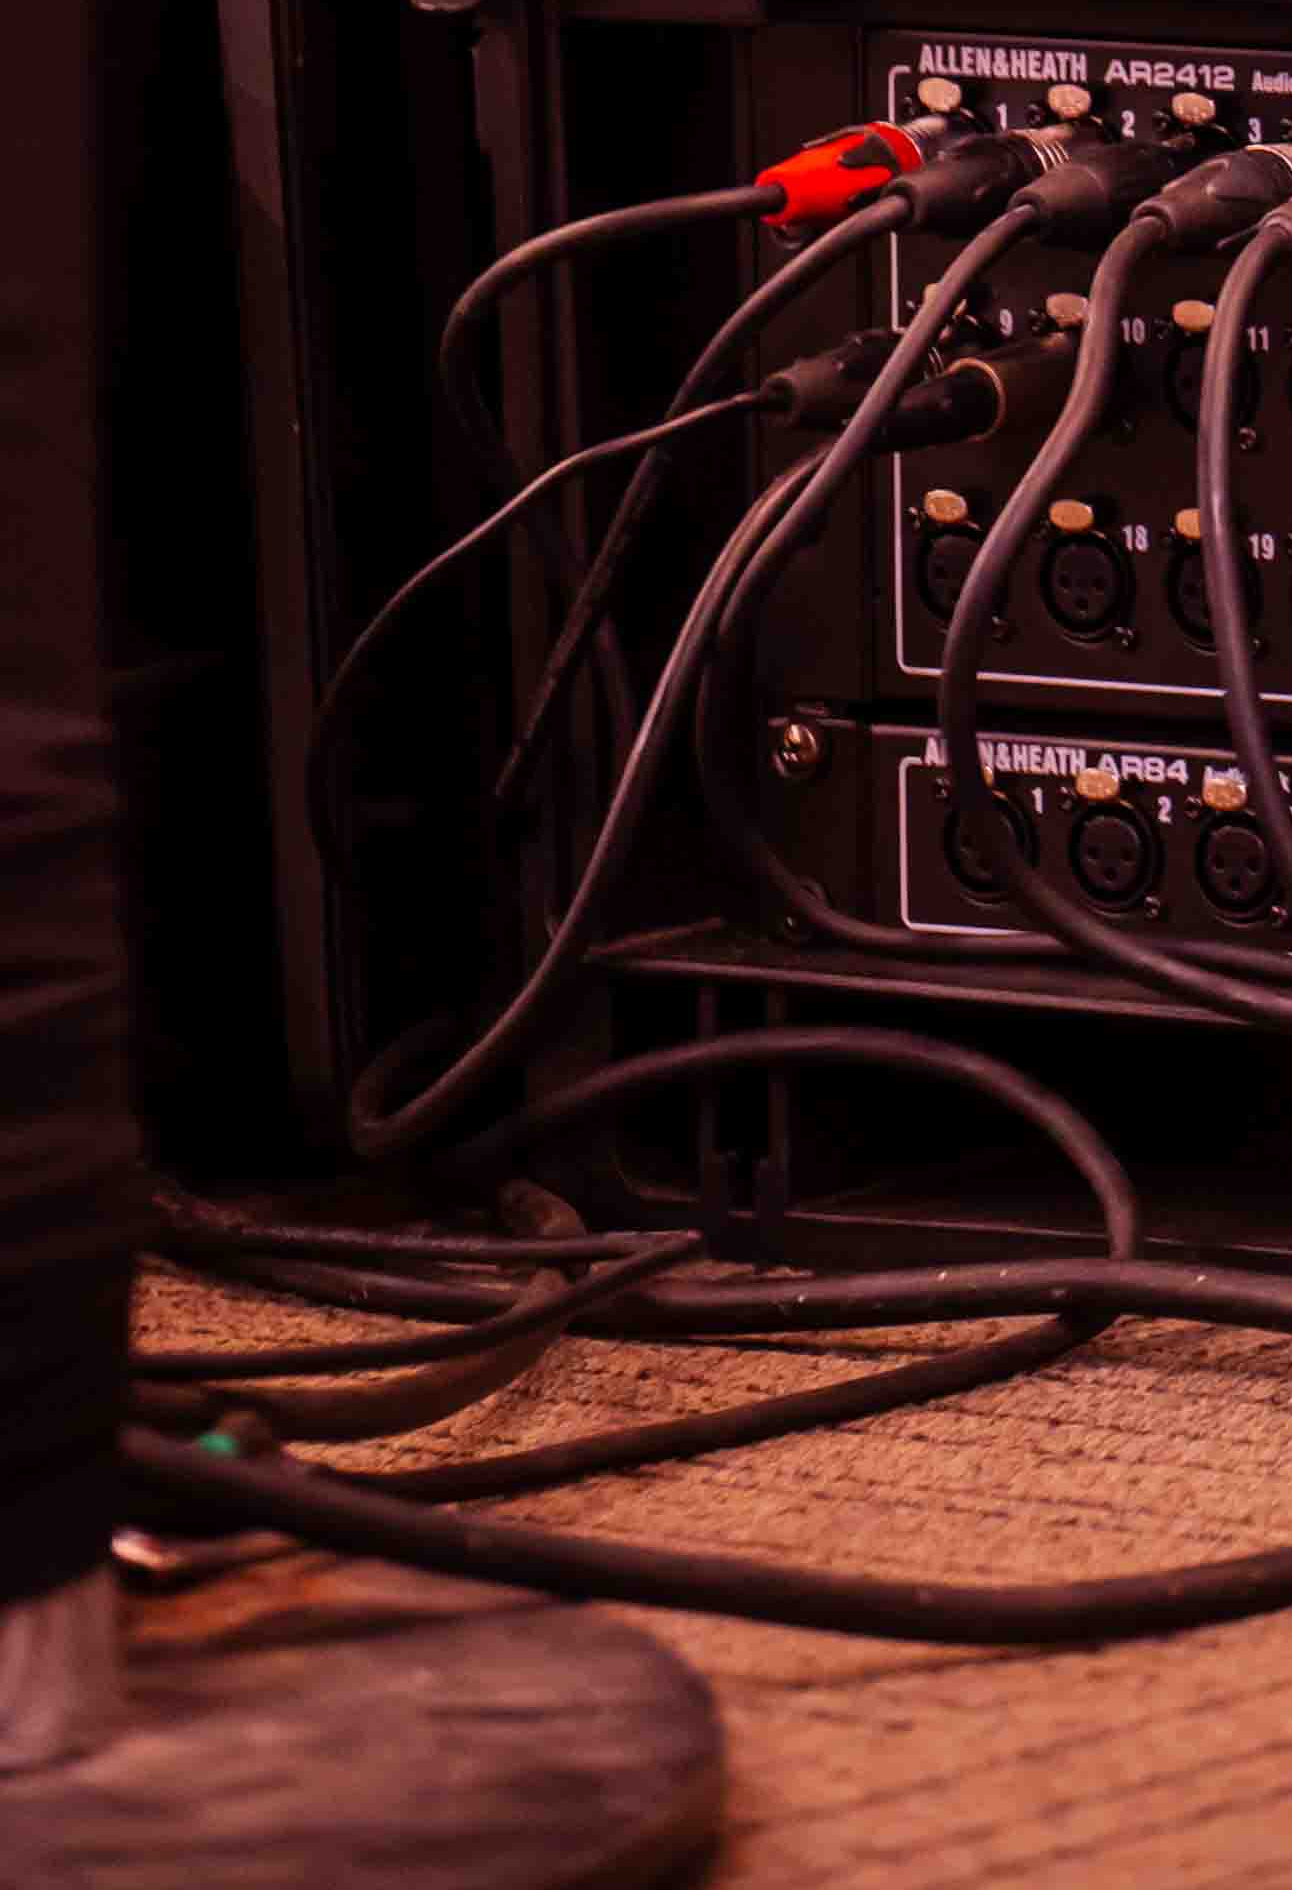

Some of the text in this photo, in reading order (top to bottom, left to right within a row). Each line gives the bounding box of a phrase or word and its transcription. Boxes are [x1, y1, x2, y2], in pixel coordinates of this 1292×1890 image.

[920, 45, 1087, 81] ALLEN&HEATH
[1104, 59, 1235, 91] AR2412
[997, 104, 1007, 131] 1
[1122, 110, 1134, 137] 2
[1248, 118, 1261, 143] 3
[1121, 318, 1145, 344] 10
[1248, 326, 1268, 351] 11
[1123, 525, 1148, 551] 18
[1249, 534, 1274, 560] 19
[1101, 755, 1187, 782] AR84
[1032, 787, 1042, 813] 1
[1158, 796, 1171, 823] 2
